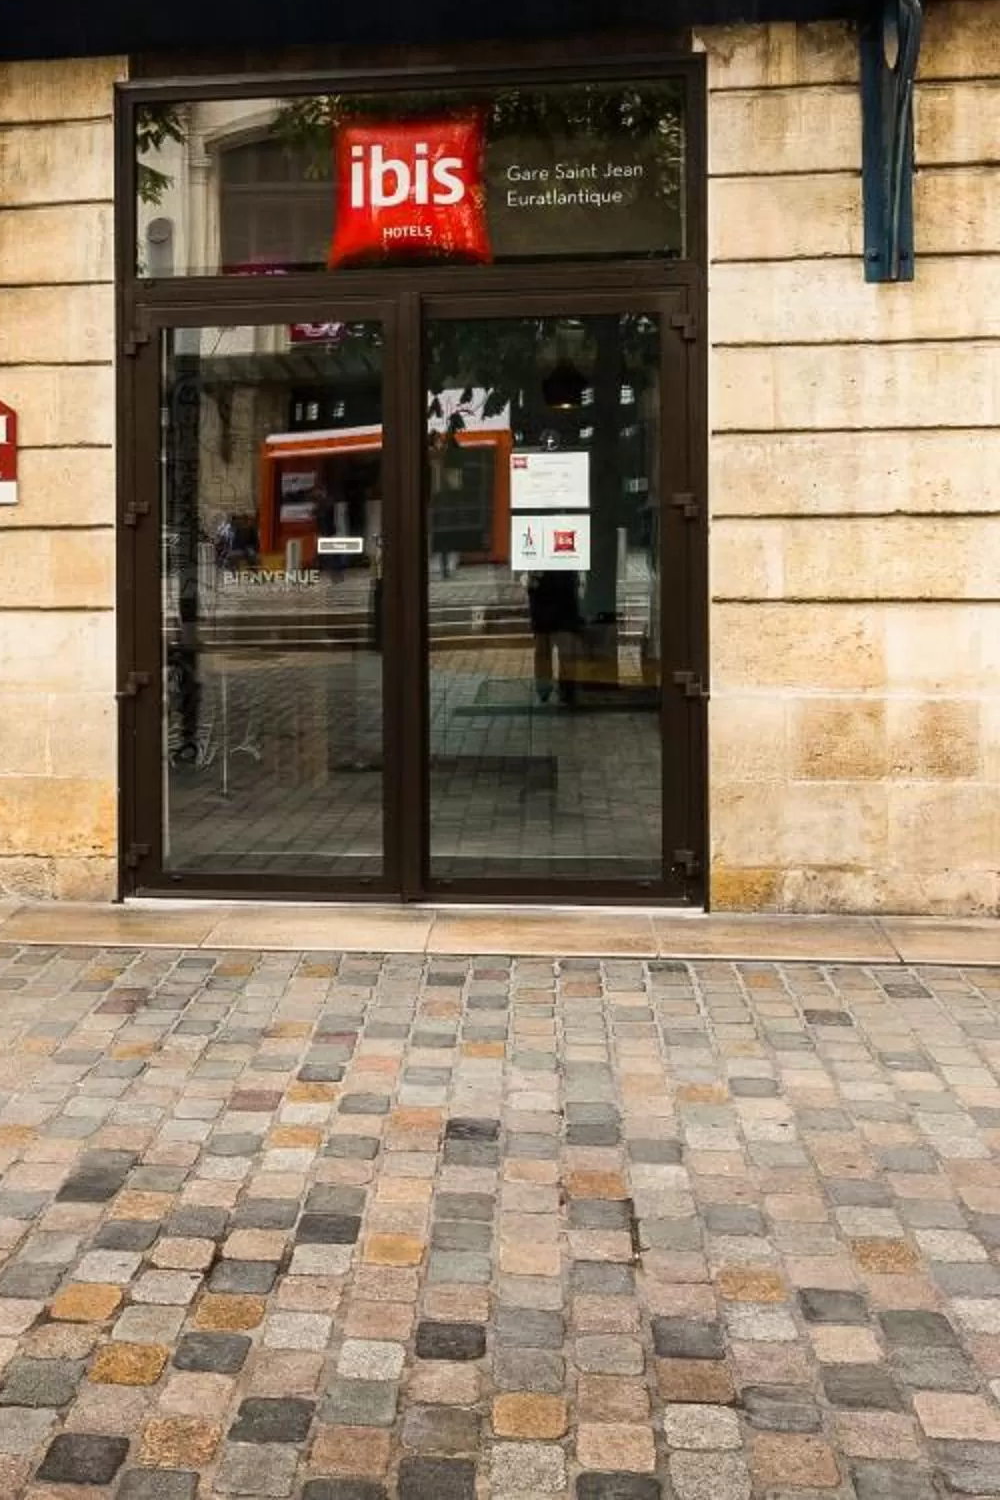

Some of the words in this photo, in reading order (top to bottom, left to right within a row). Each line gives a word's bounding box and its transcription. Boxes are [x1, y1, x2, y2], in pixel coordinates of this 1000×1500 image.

[351, 142, 465, 209] ibis
[506, 165, 550, 182] Gare
[554, 162, 597, 180] Saint
[602, 162, 644, 179] Jean
[506, 187, 624, 207] Euratlantique
[382, 225, 433, 240] HOTELS
[222, 568, 321, 586] BIENVENUE
